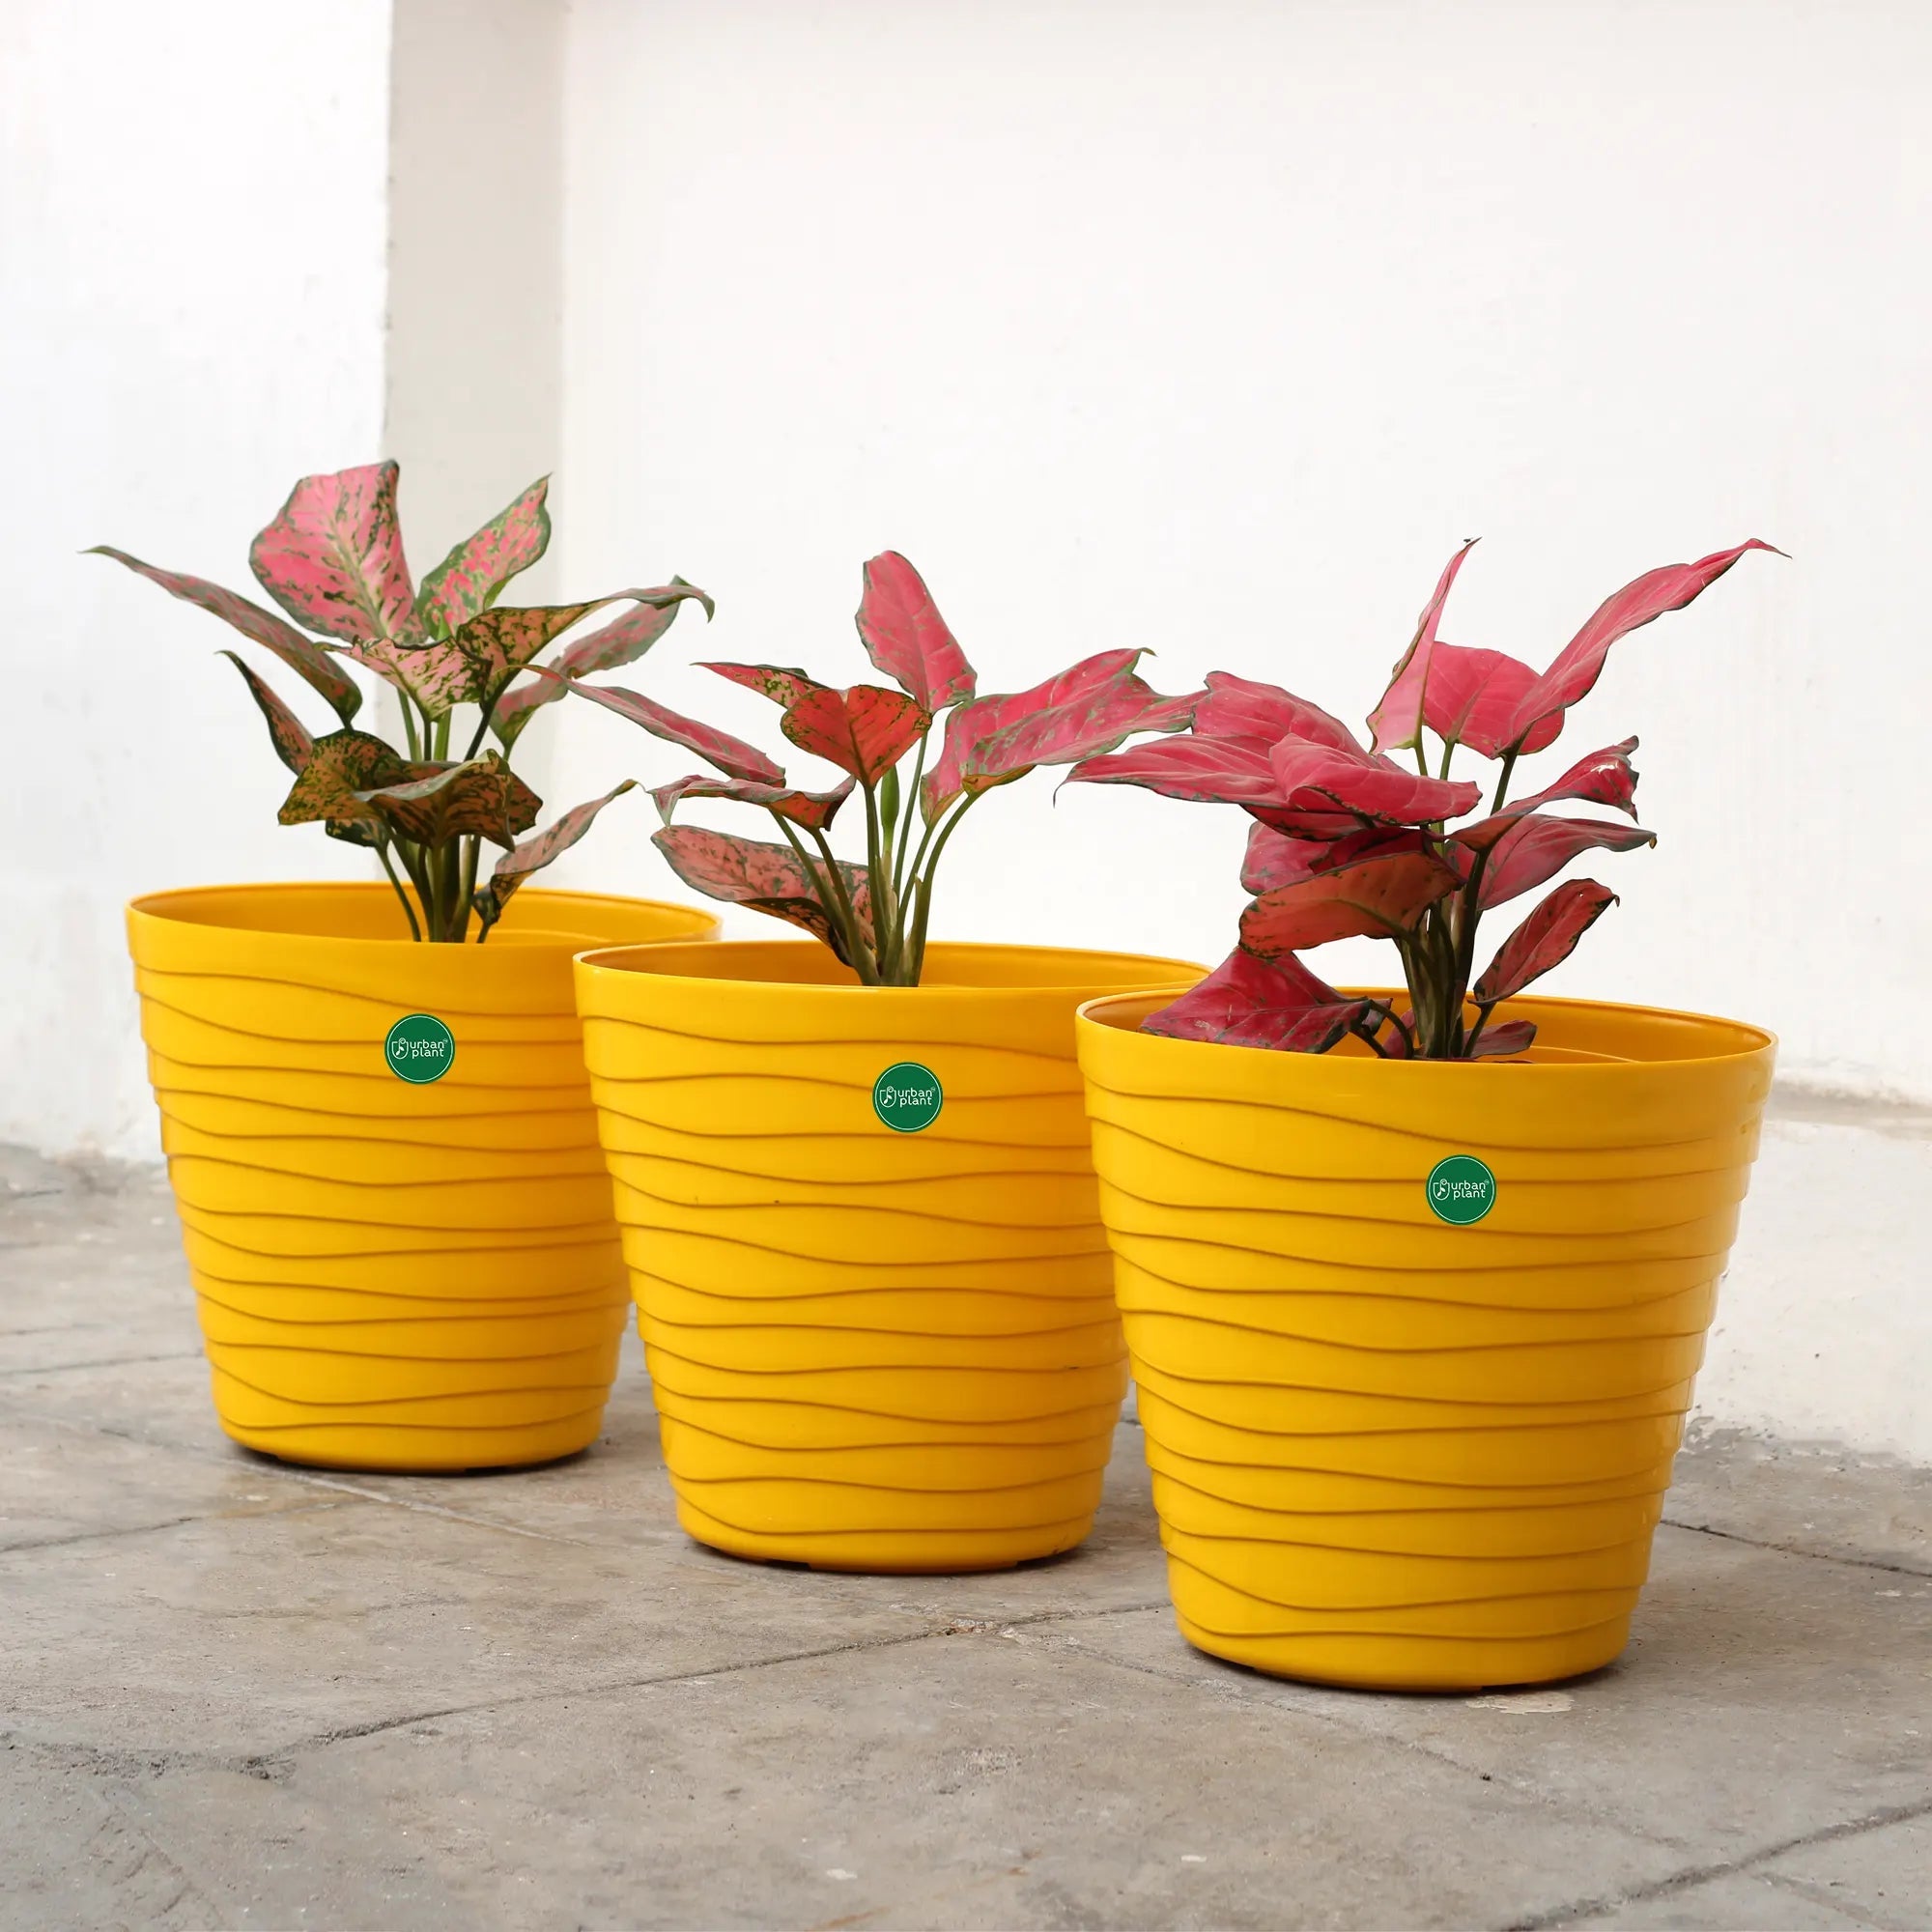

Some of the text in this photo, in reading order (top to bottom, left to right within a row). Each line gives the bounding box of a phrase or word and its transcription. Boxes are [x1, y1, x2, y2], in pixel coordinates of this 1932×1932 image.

[410, 1039, 444, 1049] urban
[412, 1047, 444, 1060] plant
[897, 1087, 932, 1097] urban
[899, 1095, 932, 1108] plant
[1451, 1179, 1486, 1190] urban
[1453, 1188, 1486, 1201] plant
